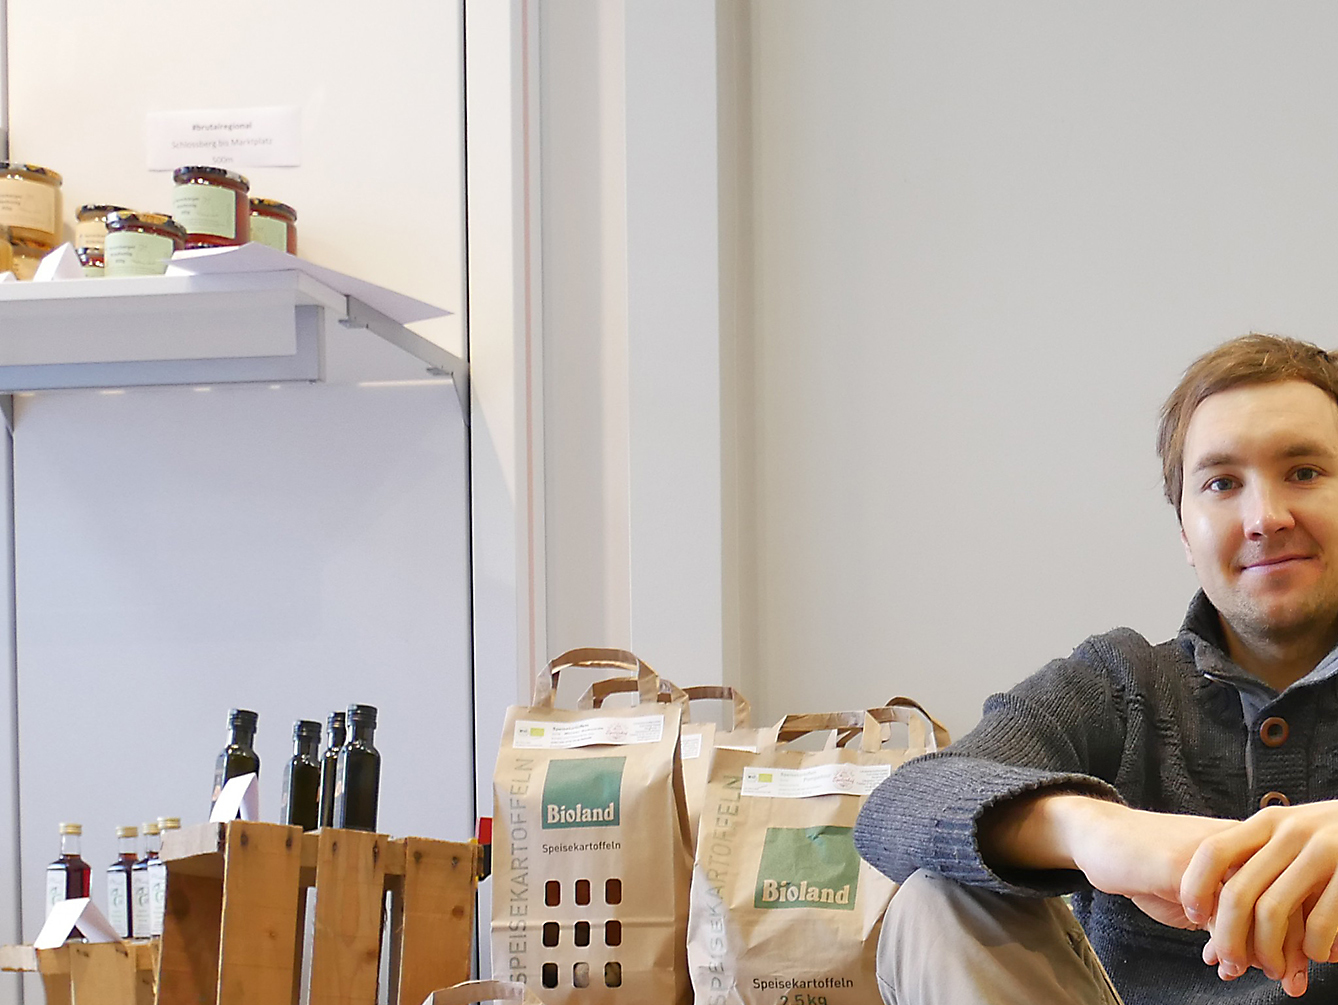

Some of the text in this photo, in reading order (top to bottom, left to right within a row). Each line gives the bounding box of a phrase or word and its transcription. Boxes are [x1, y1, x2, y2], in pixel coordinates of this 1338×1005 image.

[192, 123, 252, 132] #brutalregional
[231, 138, 273, 147] Marktplatz
[546, 803, 615, 825] Bioland
[541, 840, 621, 855] Speisekartoffeln
[508, 758, 534, 984] SPEISEKARTOFFELN
[762, 880, 850, 905] Bioland
[752, 975, 854, 990] Speisekartoffeln
